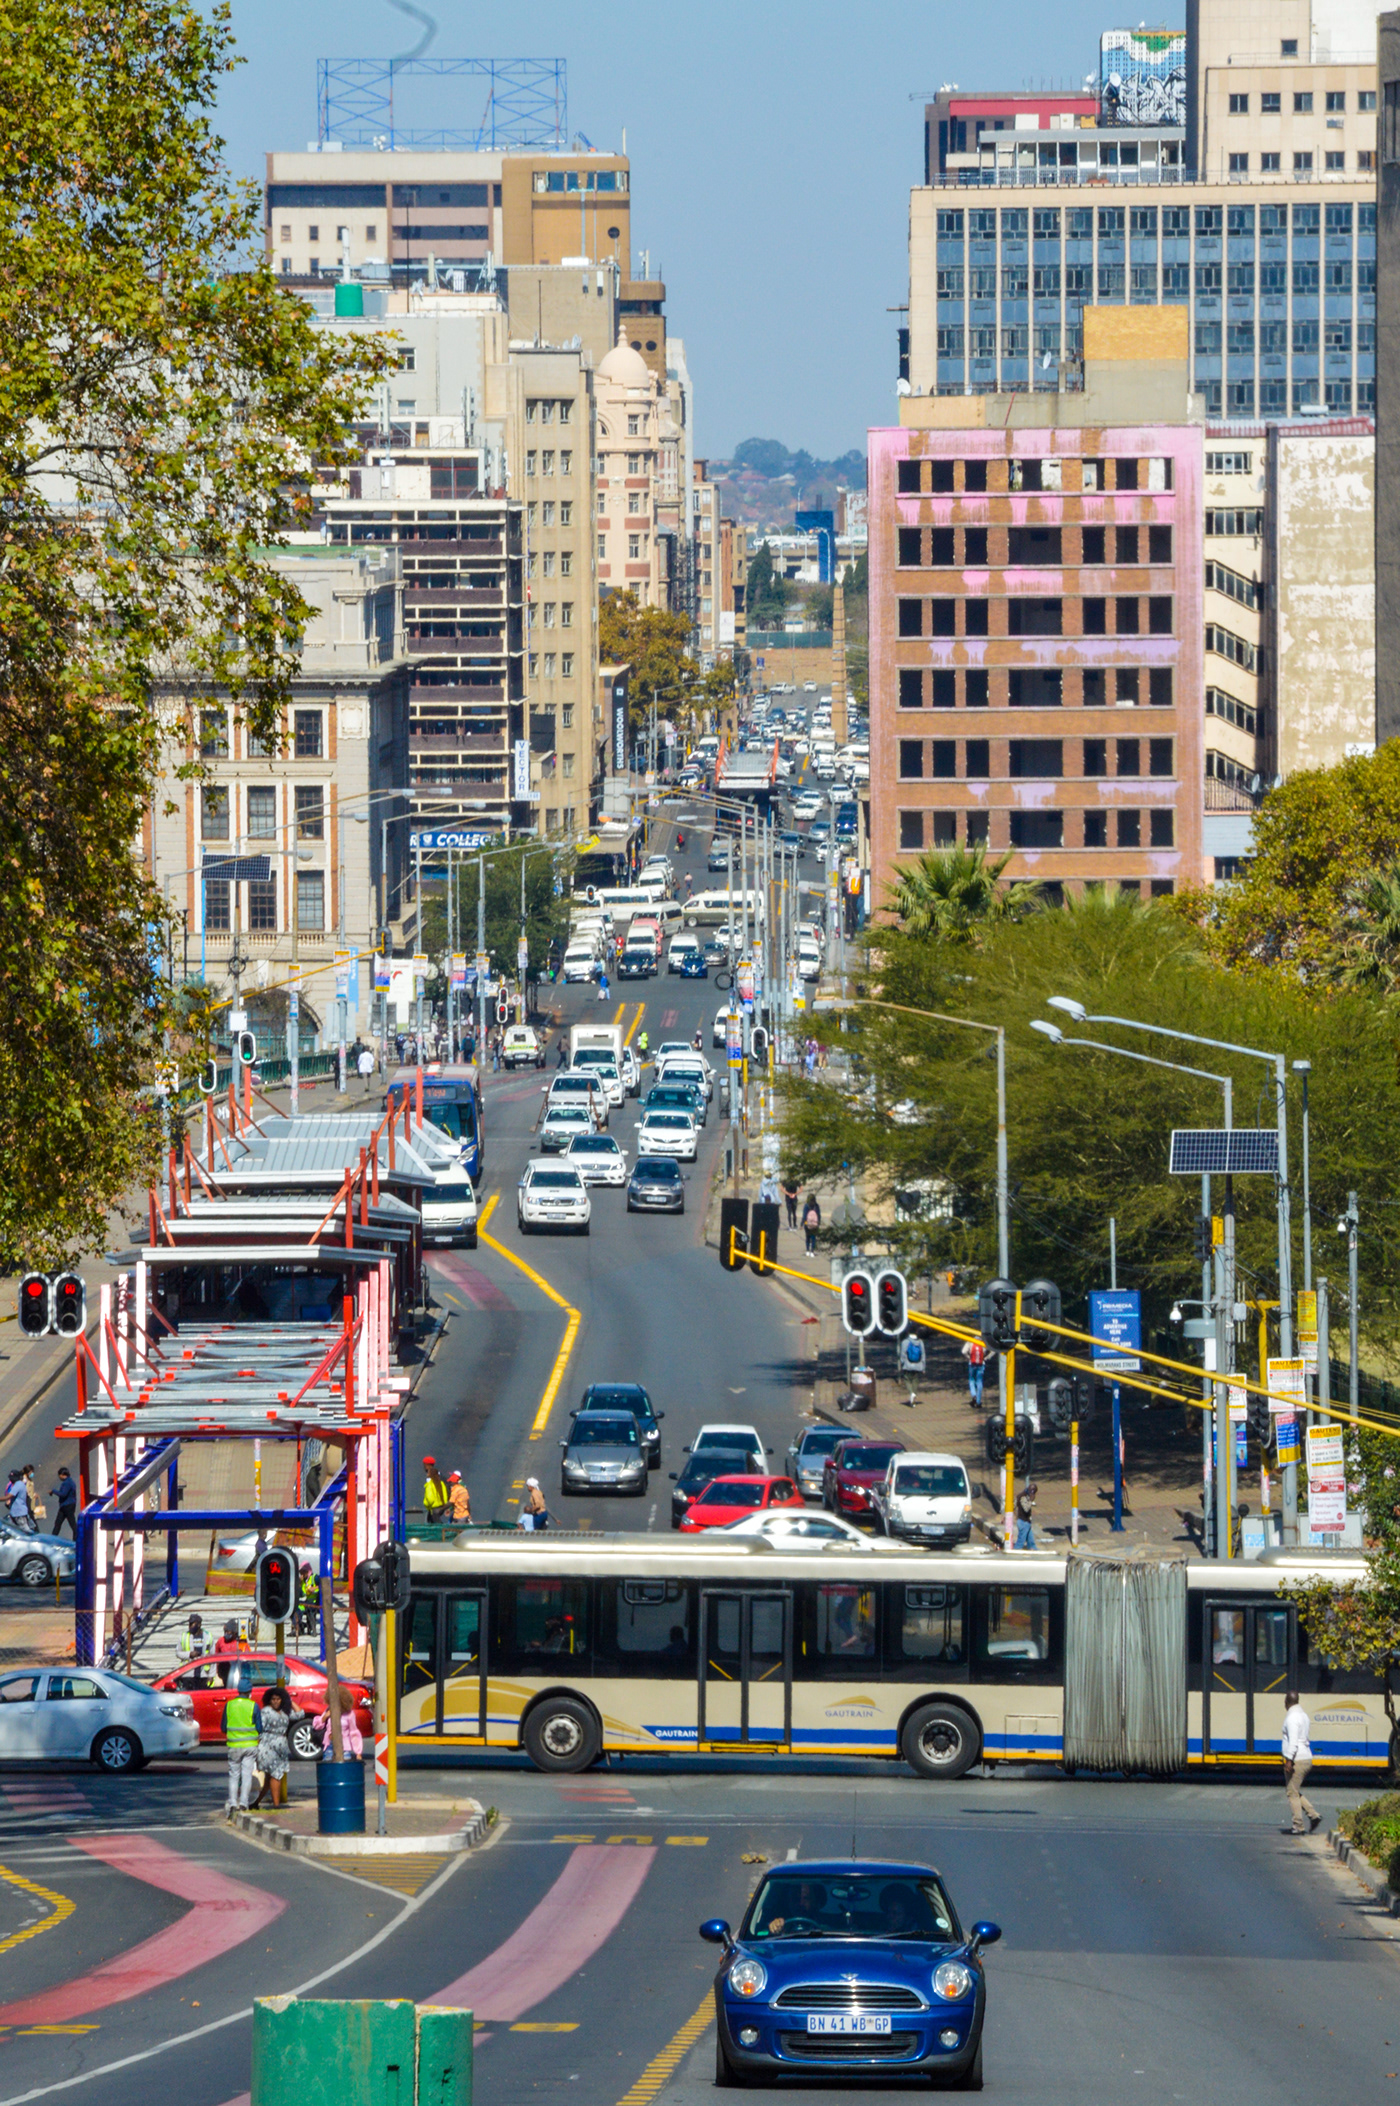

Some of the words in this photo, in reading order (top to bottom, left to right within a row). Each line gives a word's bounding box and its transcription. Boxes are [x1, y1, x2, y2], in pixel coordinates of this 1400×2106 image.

[616, 707, 624, 770] WOOLWORTHS
[518, 742, 526, 791] VECTOR
[825, 1710, 873, 1718] GAUTRAIN
[1314, 1714, 1364, 1722] GAUTRAIN
[655, 1730, 698, 1738] GAUTRAIN
[809, 2017, 825, 2030] BN
[831, 2017, 845, 2031] 41
[851, 2018, 866, 2031] WB
[875, 2018, 889, 2031] GP
